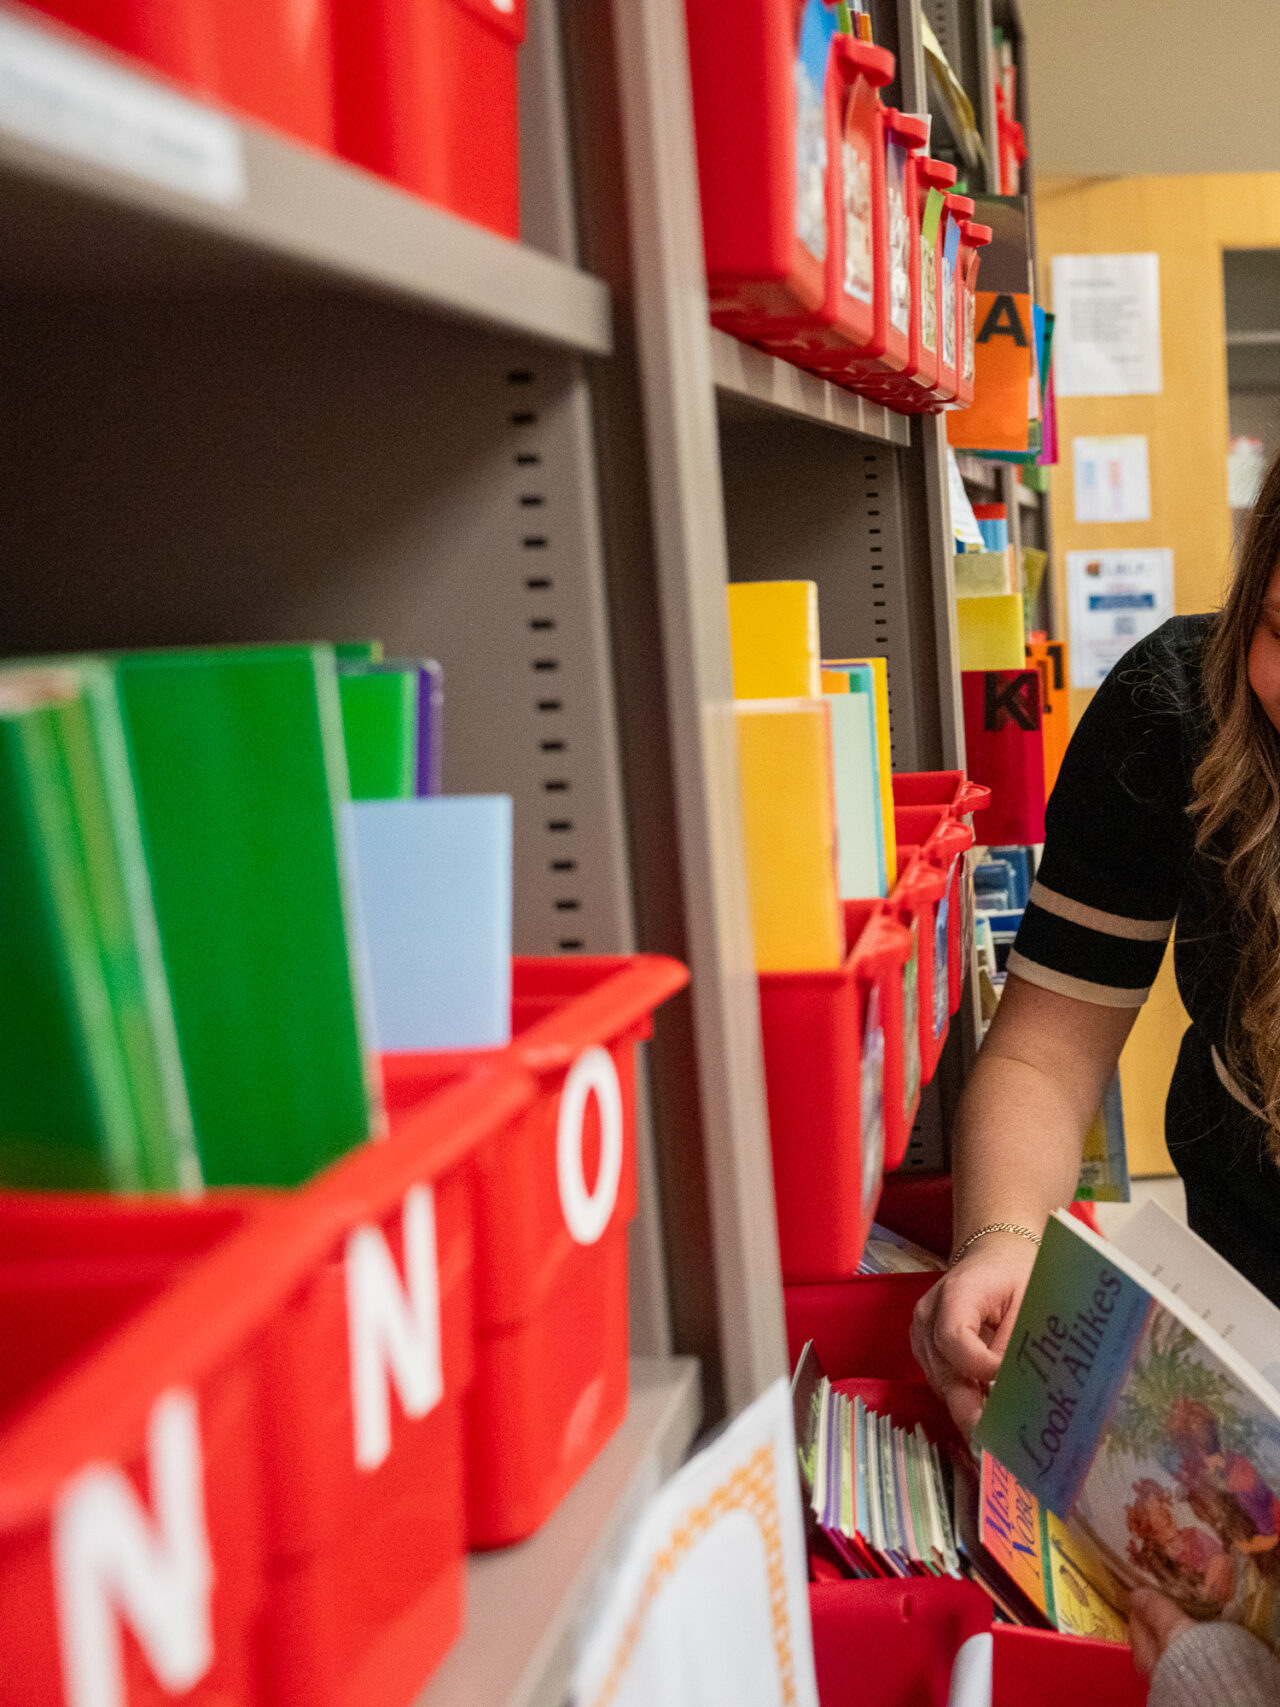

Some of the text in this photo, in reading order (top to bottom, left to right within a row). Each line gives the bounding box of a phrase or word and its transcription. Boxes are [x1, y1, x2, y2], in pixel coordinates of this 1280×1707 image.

[976, 295, 1028, 347] A
[984, 672, 1039, 731] K
[557, 1048, 623, 1245] O
[345, 1184, 444, 1470] N
[1017, 1314, 1068, 1383] The
[1019, 1389, 1077, 1483] Look
[1063, 1270, 1122, 1388] Alikes
[56, 1388, 215, 1706] N
